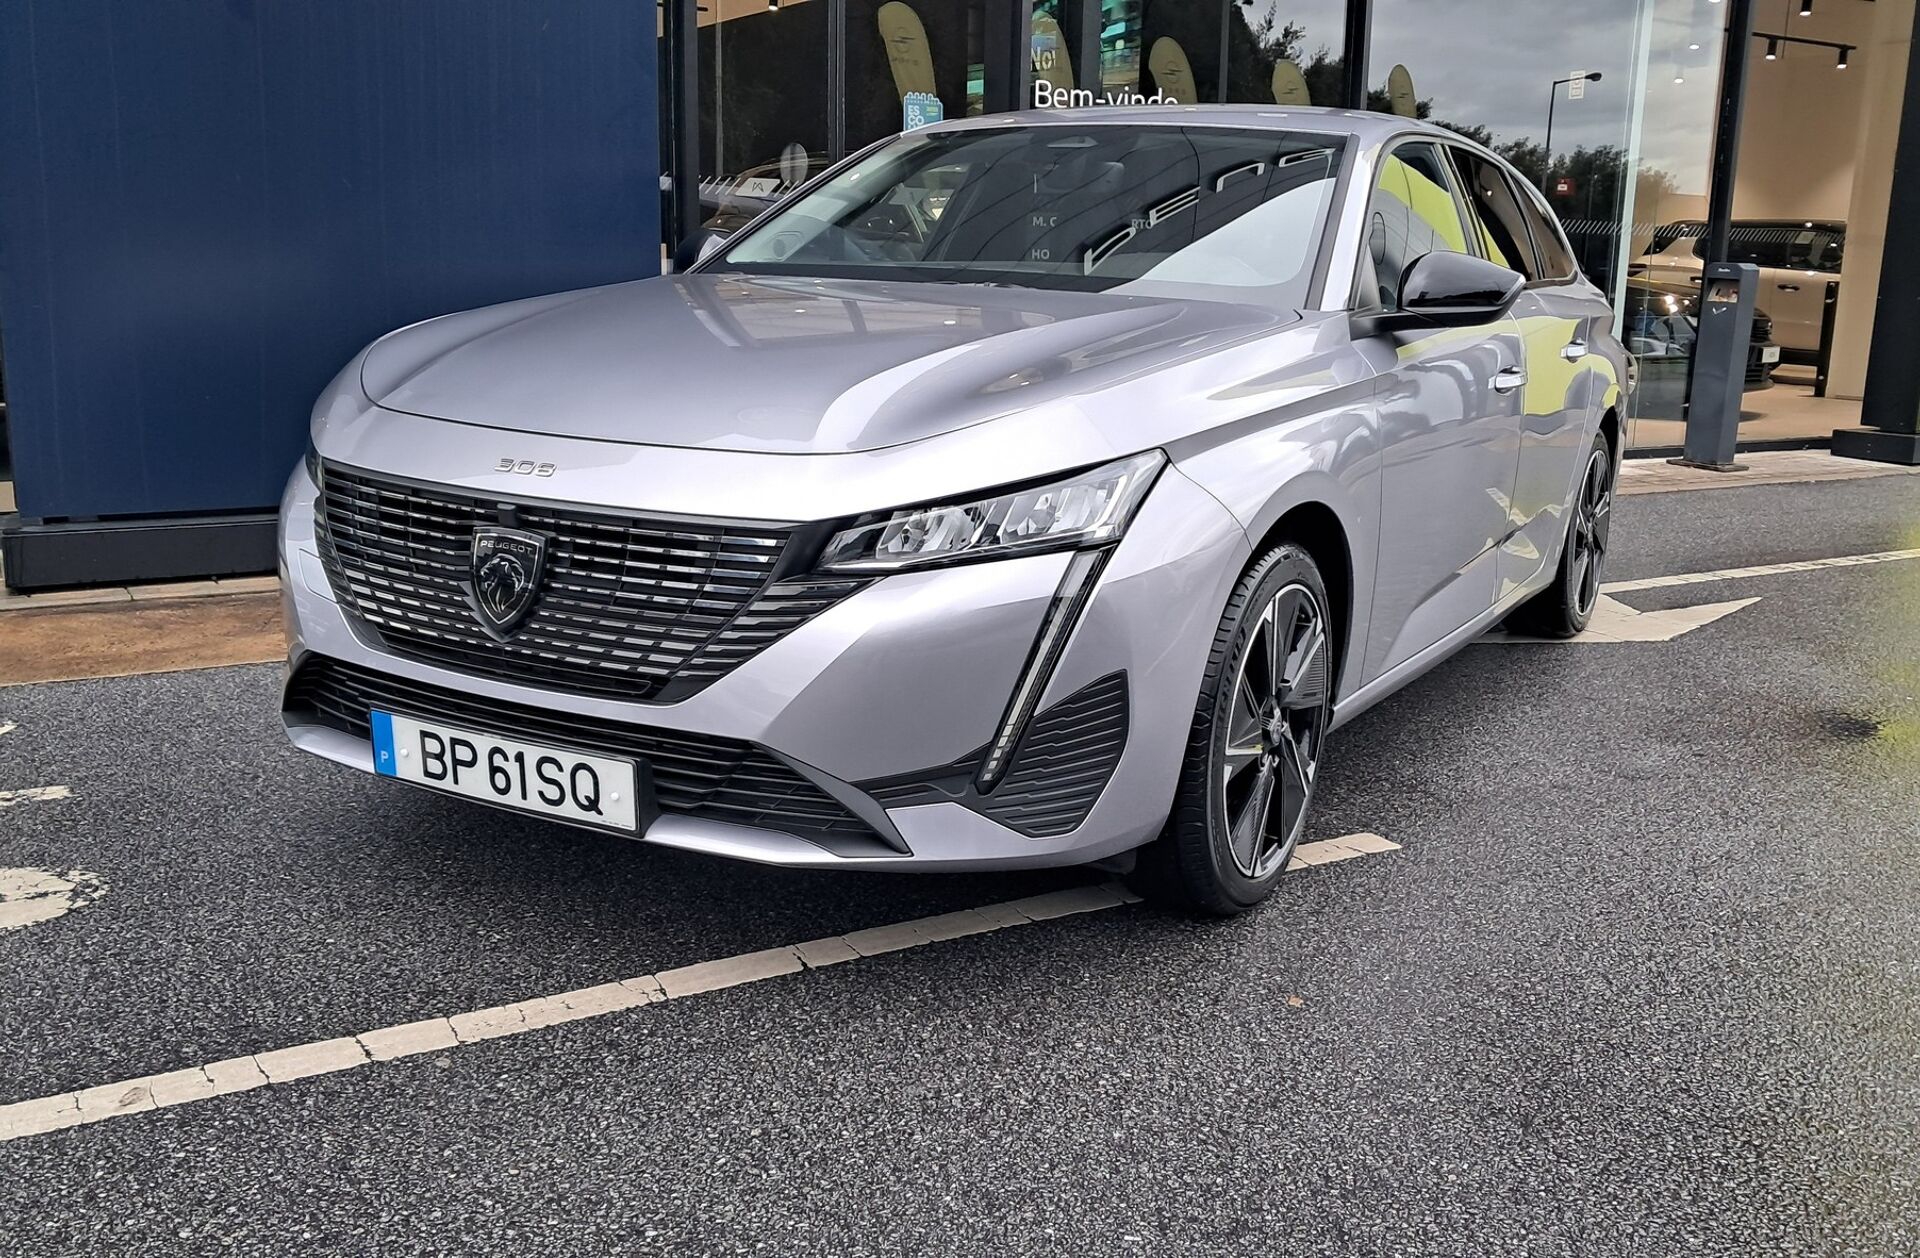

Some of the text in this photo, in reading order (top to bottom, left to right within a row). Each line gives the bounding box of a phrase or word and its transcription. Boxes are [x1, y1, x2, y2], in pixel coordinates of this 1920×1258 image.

[494, 458, 557, 478] 308
[480, 540, 534, 555] PEUGEOT
[380, 751, 389, 763] P
[419, 729, 604, 816] BP 61 SQ
